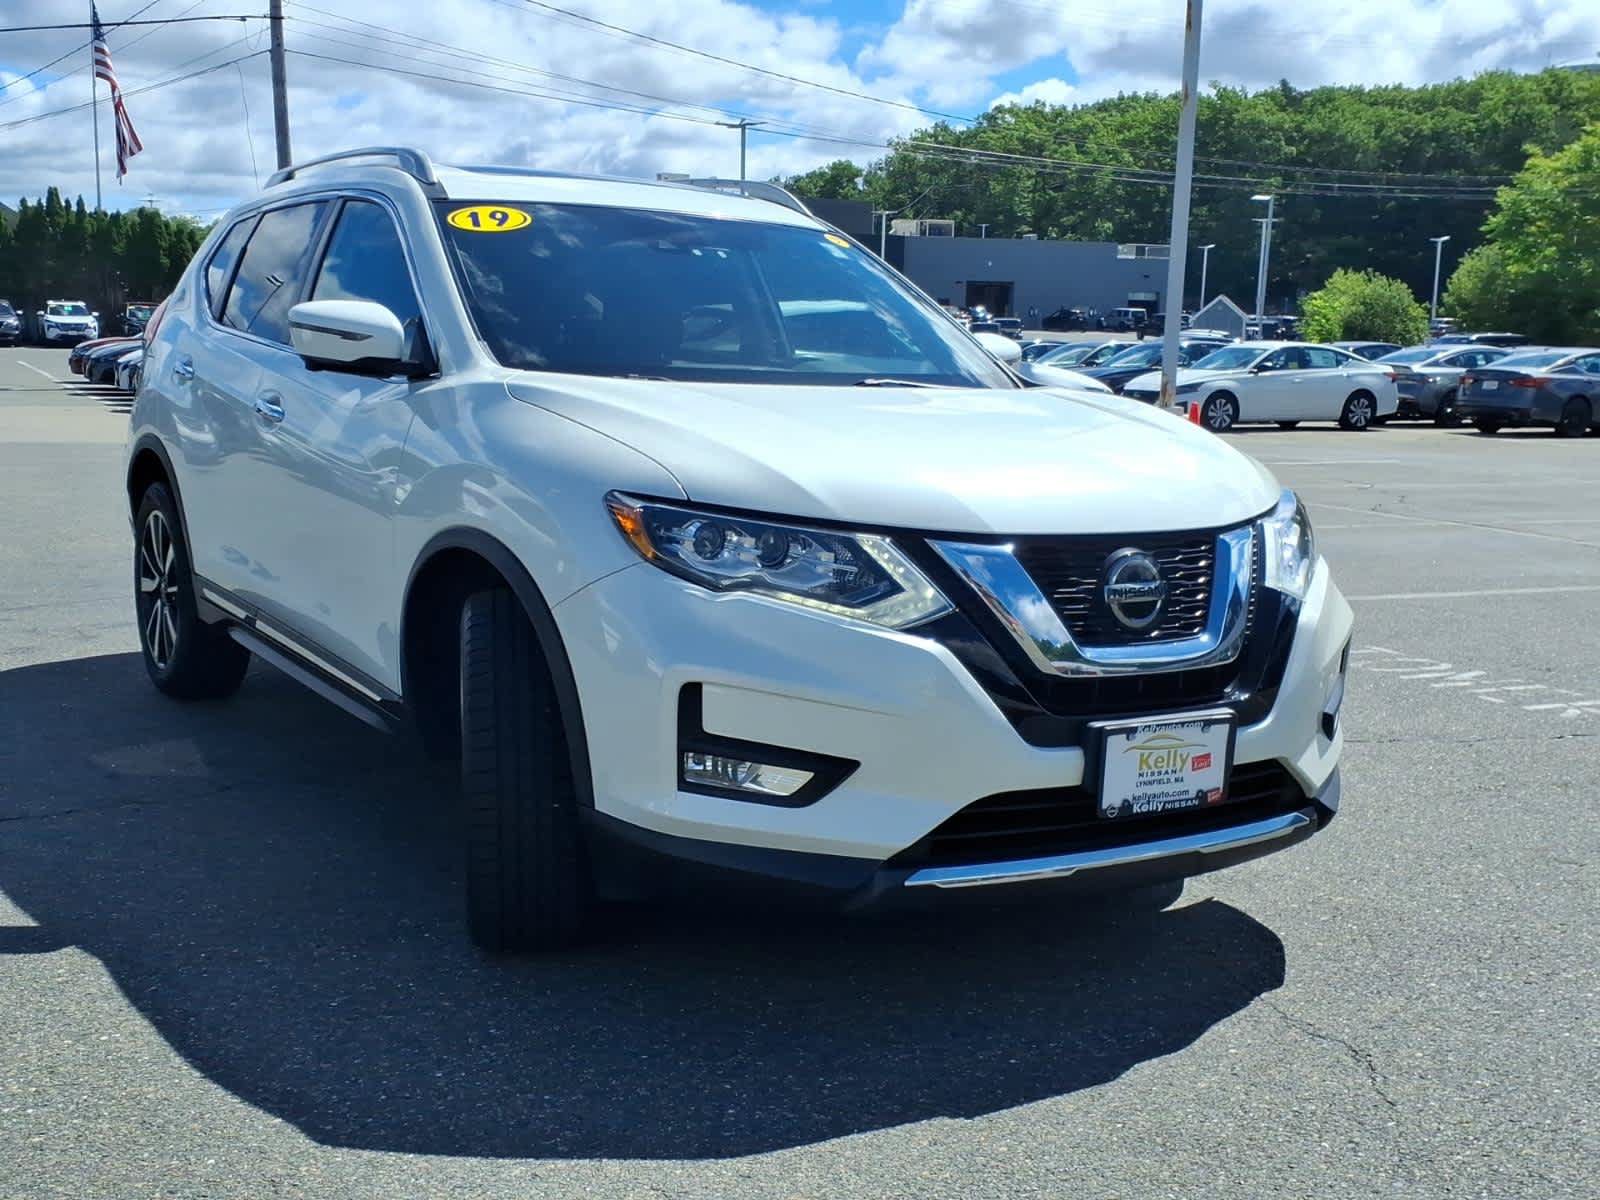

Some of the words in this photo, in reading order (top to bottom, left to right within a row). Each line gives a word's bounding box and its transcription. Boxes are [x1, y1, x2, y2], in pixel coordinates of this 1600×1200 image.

[467, 210, 509, 228] 19
[1110, 584, 1164, 600] NISSAN
[1138, 749, 1191, 772] Kelly
[1138, 769, 1177, 778] NISSAN
[1132, 790, 1190, 801] kellyauto.com
[1132, 800, 1165, 813] Kelly
[1165, 799, 1199, 809] NISSAN
